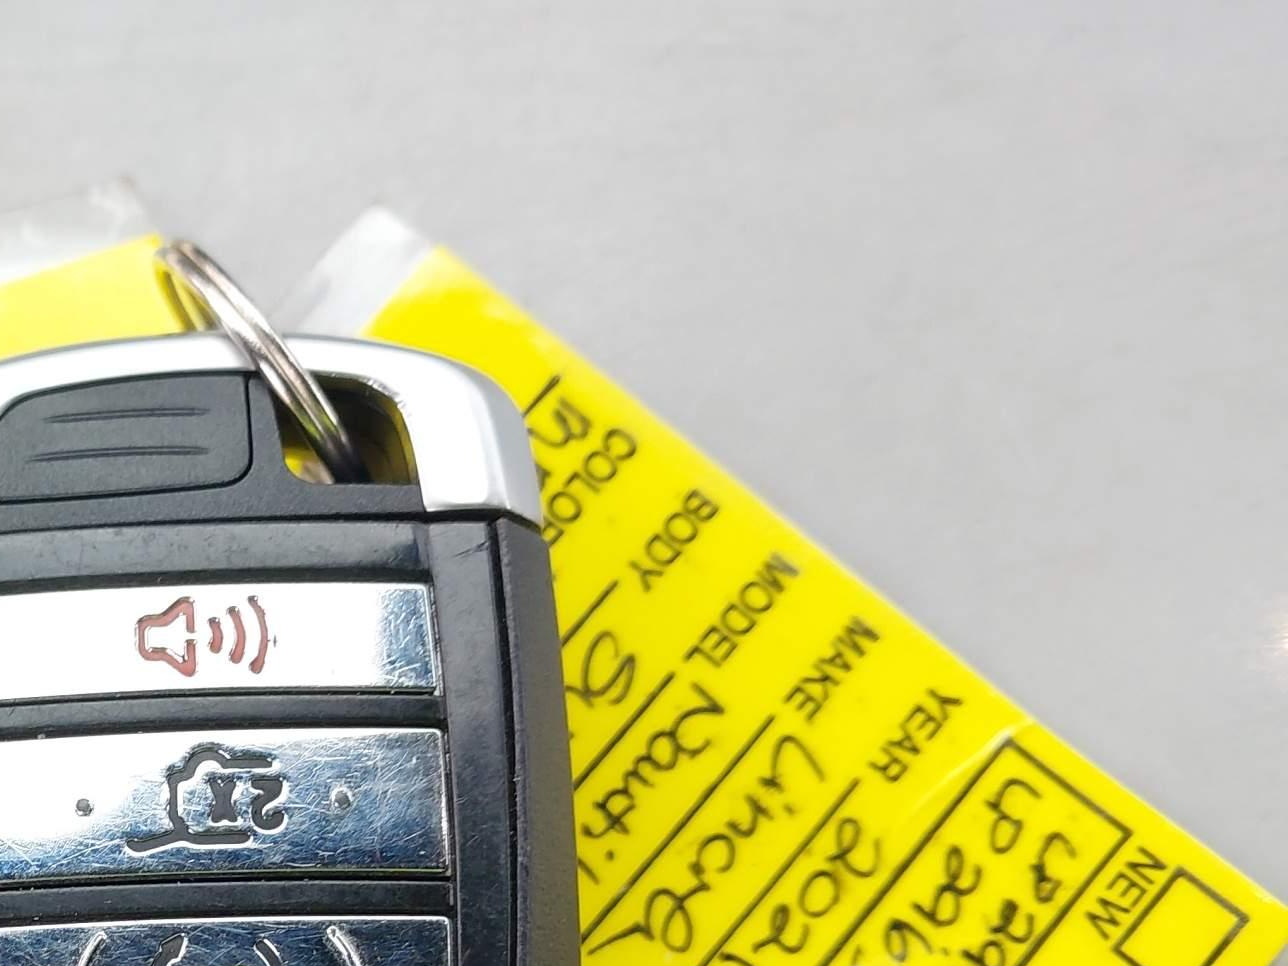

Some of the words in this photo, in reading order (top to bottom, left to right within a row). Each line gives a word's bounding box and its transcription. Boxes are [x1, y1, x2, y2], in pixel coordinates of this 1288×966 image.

[629, 489, 719, 592] BODY
[683, 555, 798, 668] MODEL
[784, 618, 880, 722] MAKE
[869, 689, 963, 783] YEAR
[1086, 847, 1167, 940] NEW
